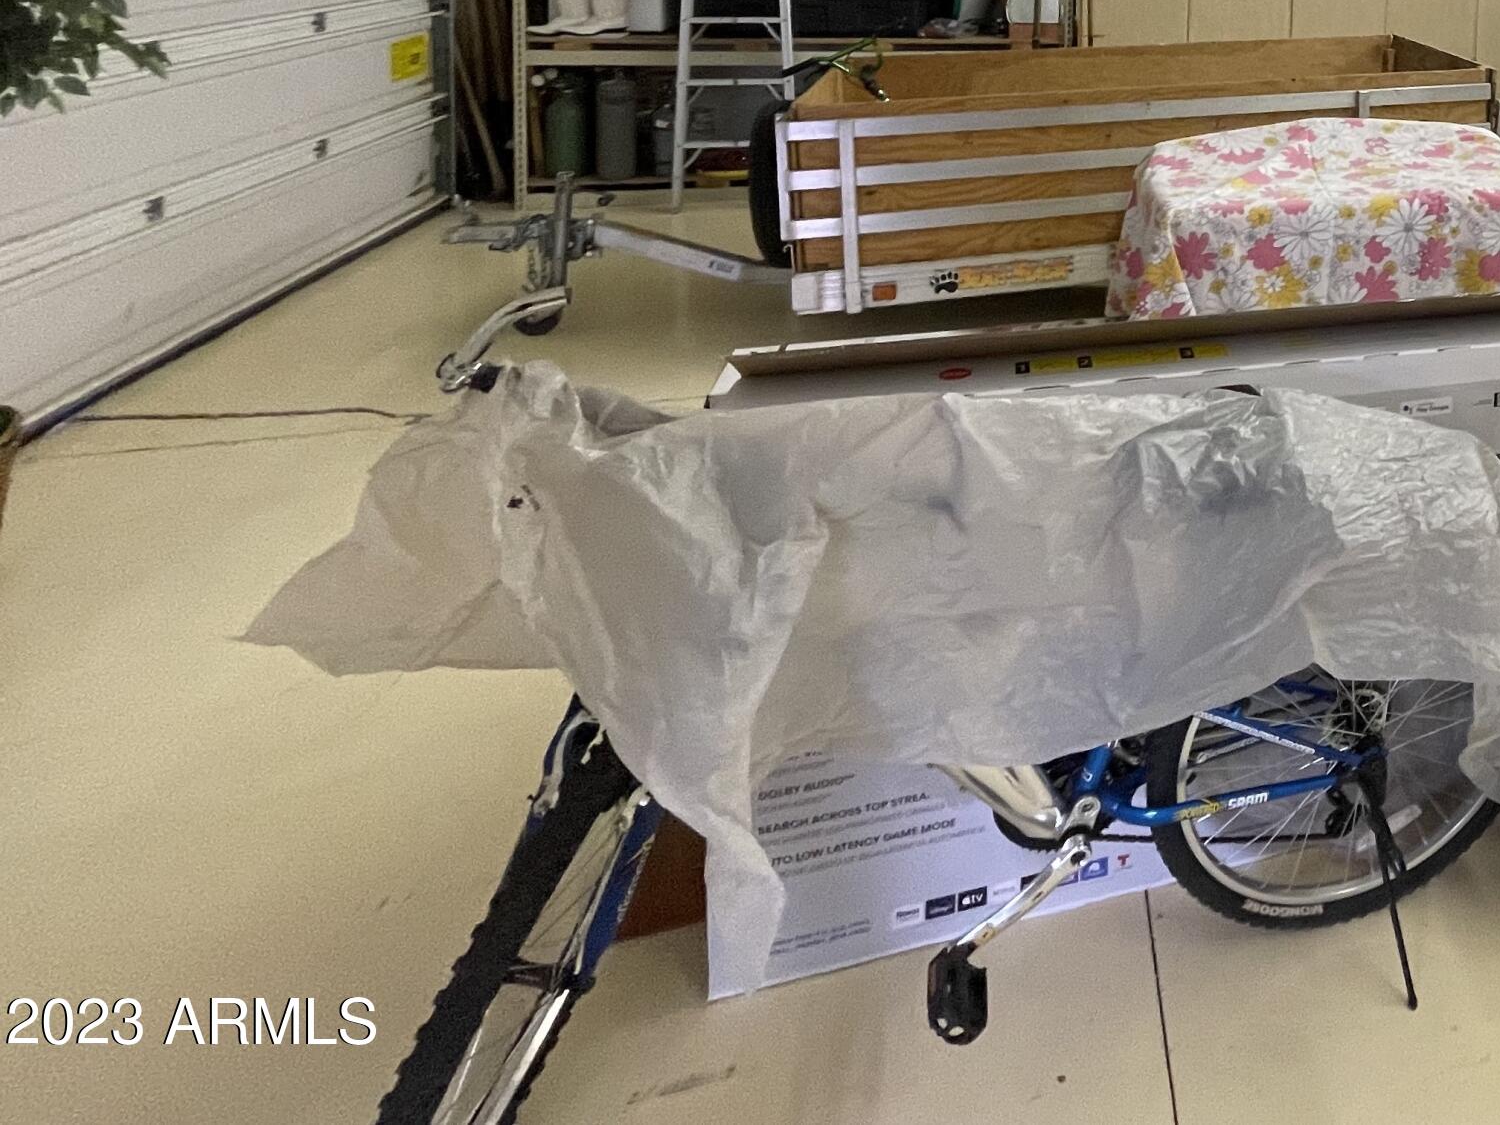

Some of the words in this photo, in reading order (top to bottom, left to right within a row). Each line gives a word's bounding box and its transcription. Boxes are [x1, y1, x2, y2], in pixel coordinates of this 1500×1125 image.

[758, 818, 809, 836] SEARCH
[811, 807, 862, 825] ACROSS
[865, 799, 889, 813] TOP
[891, 792, 931, 807] STREA
[795, 846, 825, 863] LOW
[826, 835, 881, 854] LATENCY
[883, 827, 917, 843] GAME
[920, 818, 957, 835] MODE
